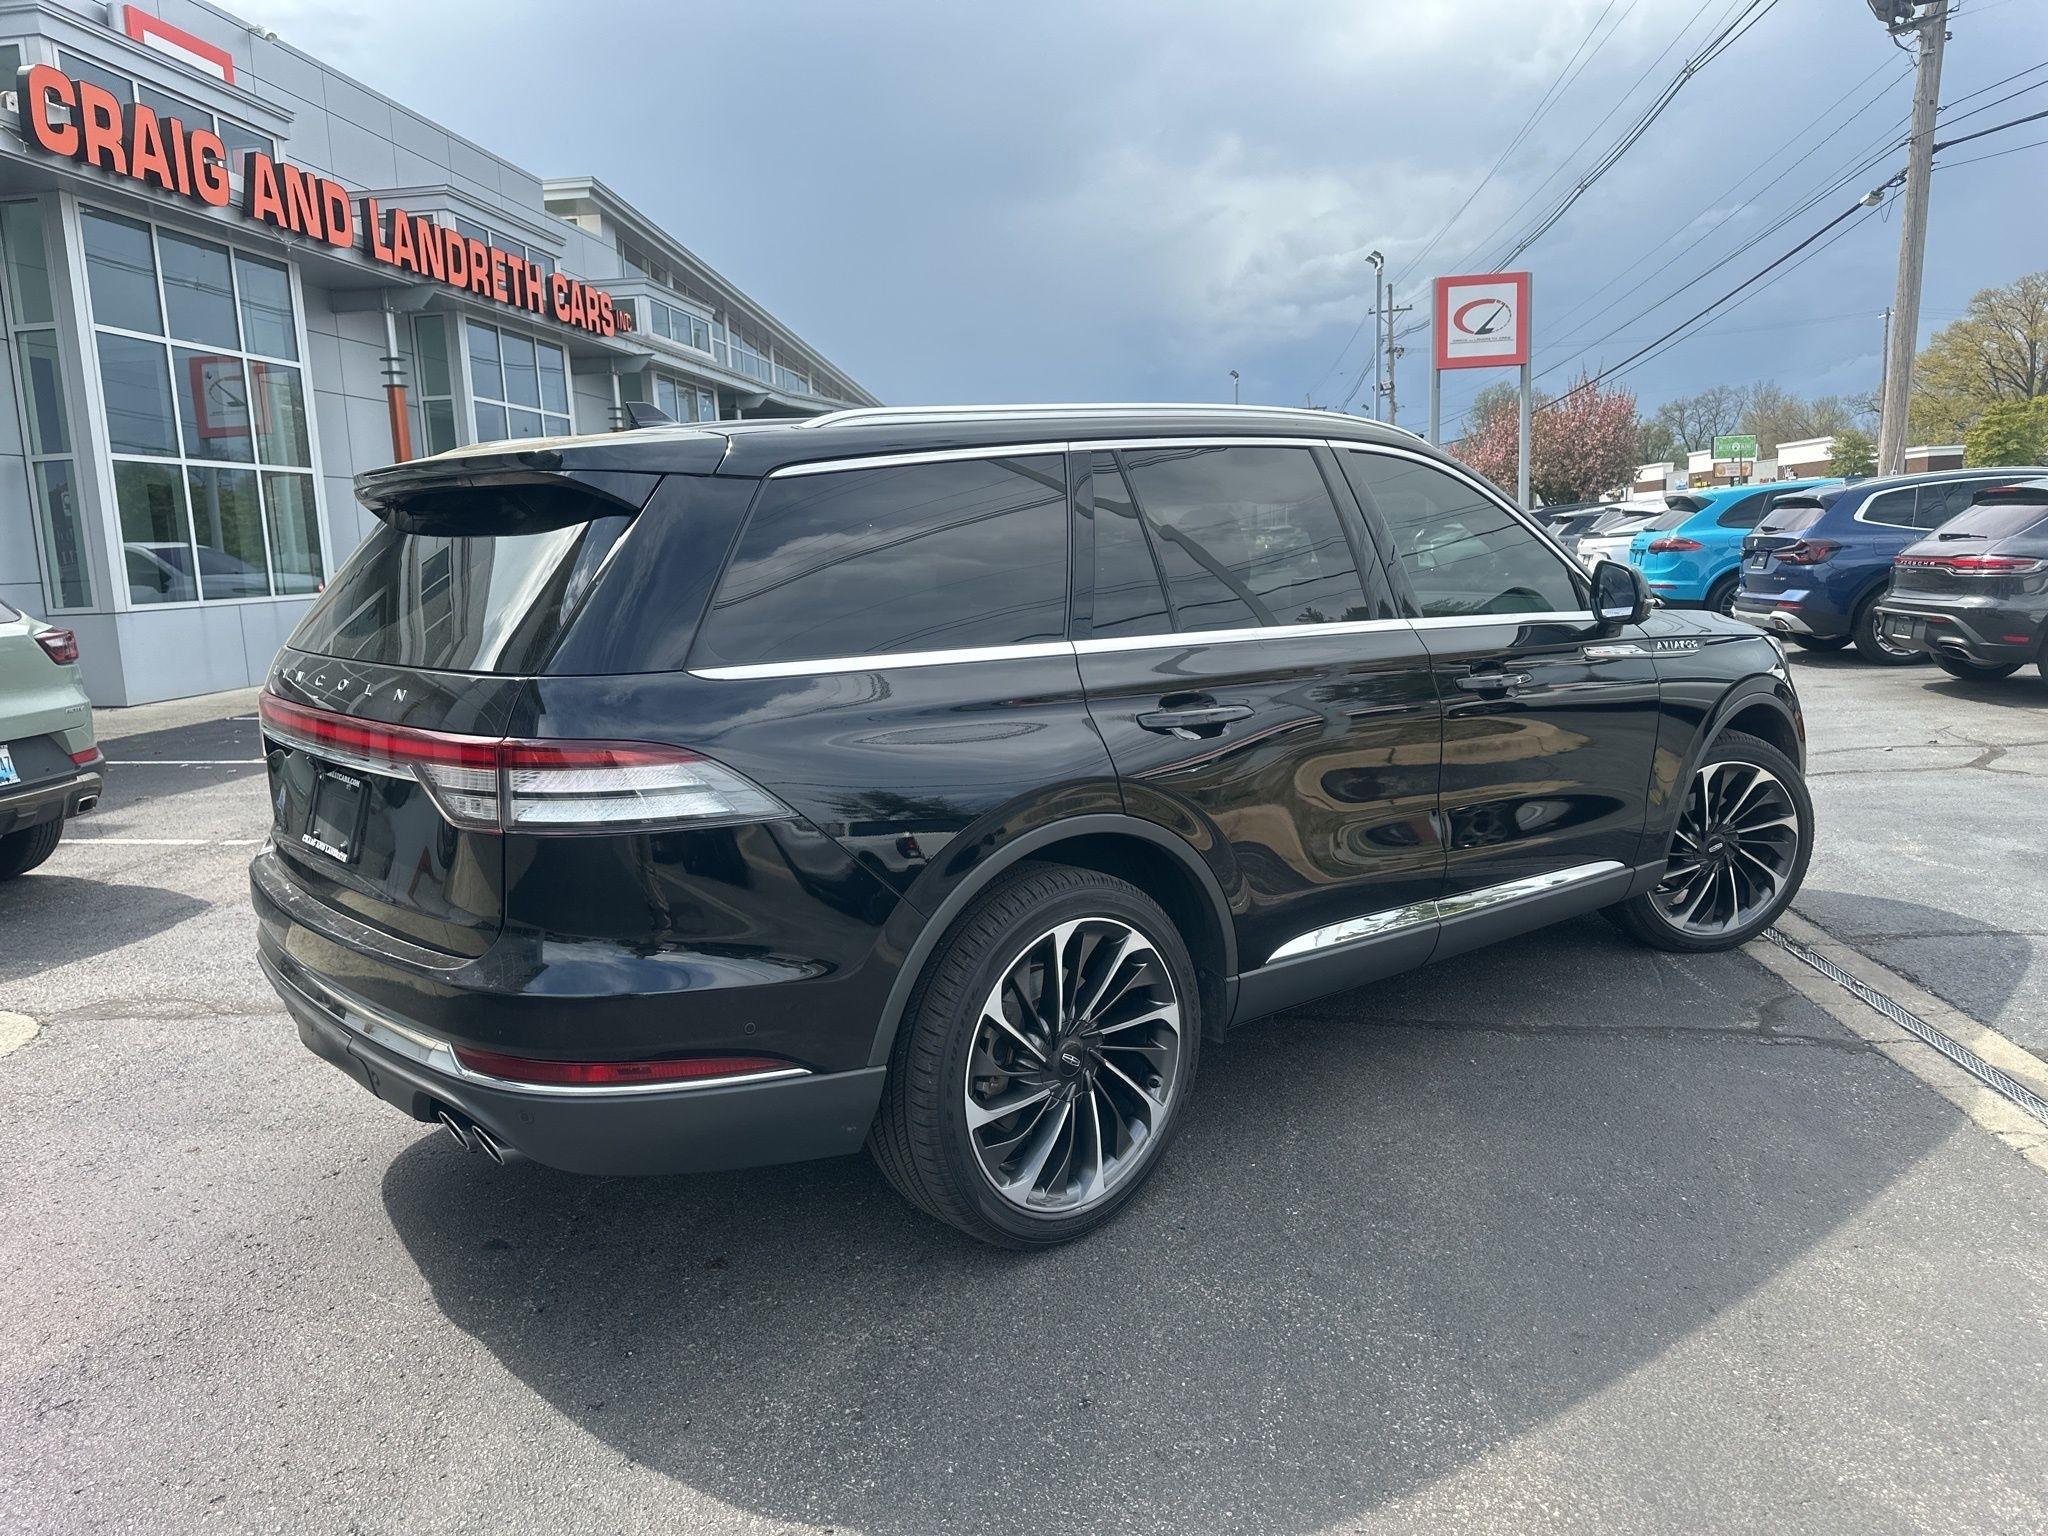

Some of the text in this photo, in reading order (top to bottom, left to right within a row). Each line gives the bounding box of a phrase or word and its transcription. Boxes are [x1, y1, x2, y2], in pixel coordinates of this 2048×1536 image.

[26, 64, 633, 337] CRAIG AND LANDRETH CARS INC
[1657, 638, 1698, 650] AVIATOR
[273, 665, 407, 702] LINCOLN
